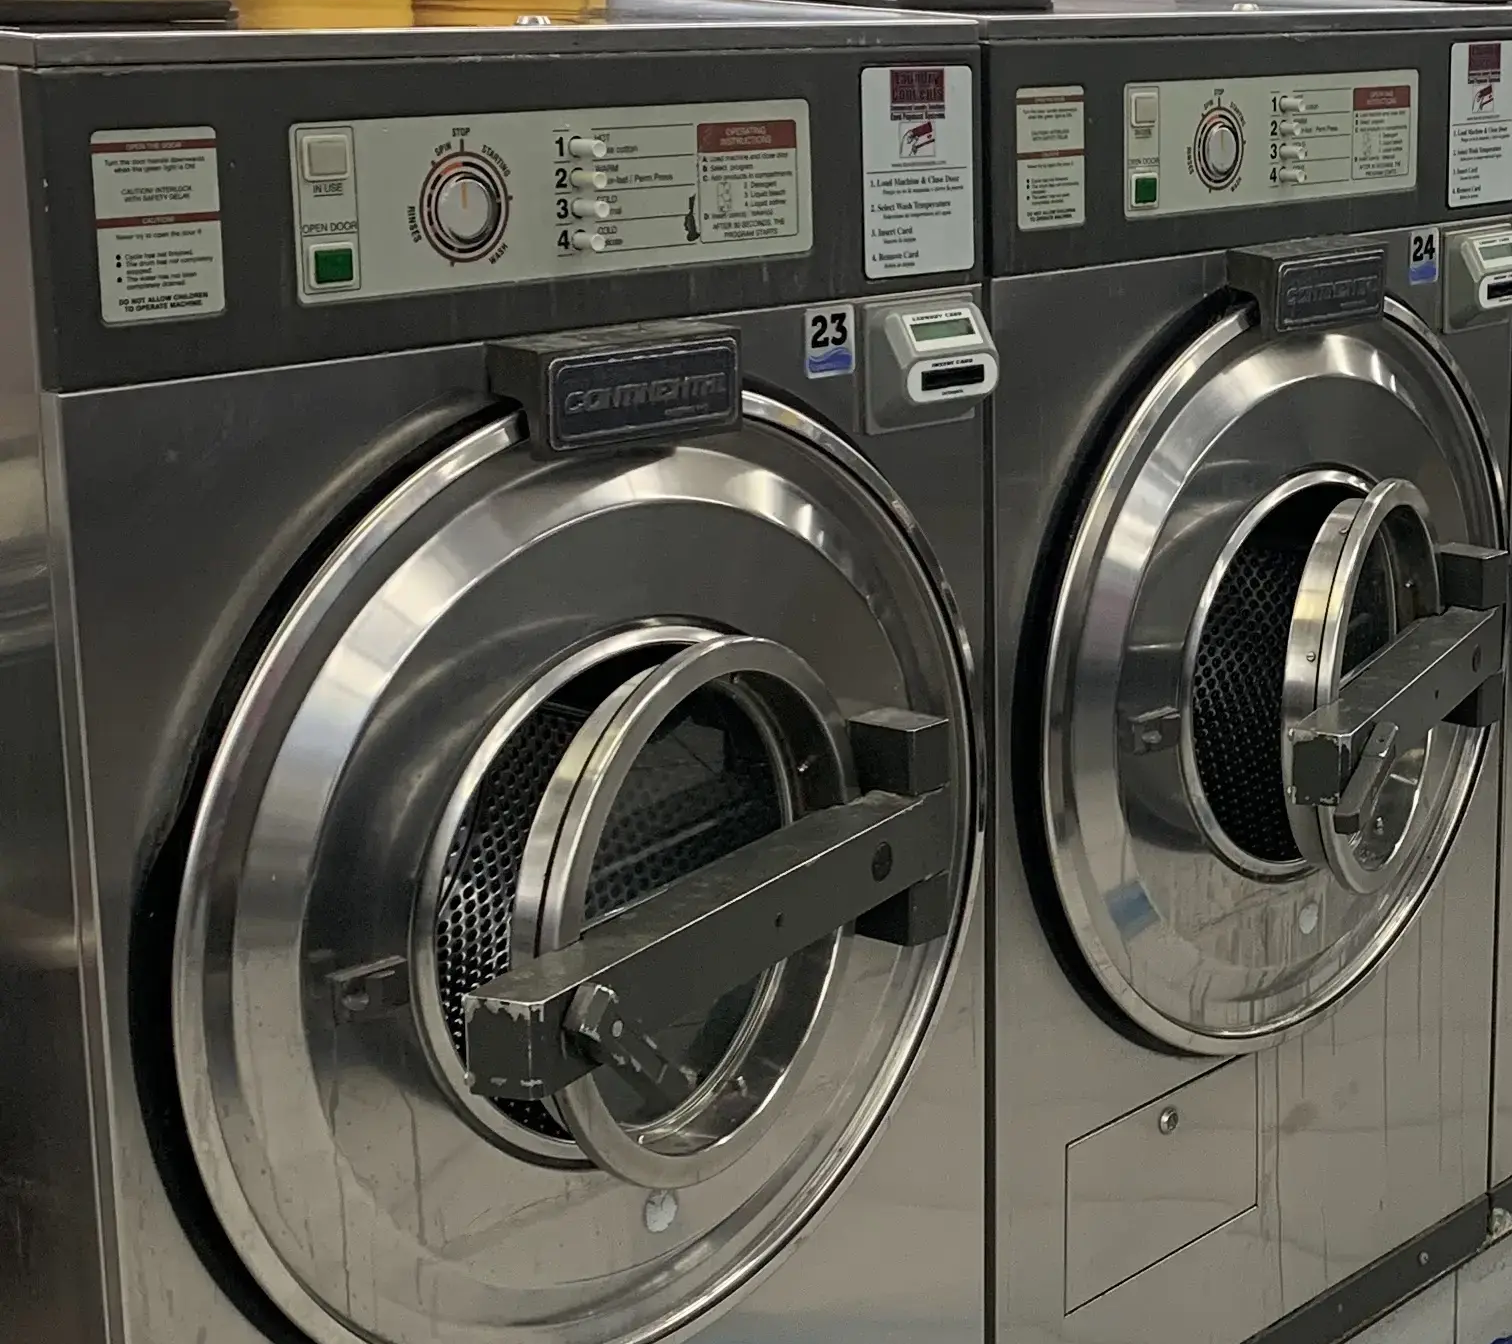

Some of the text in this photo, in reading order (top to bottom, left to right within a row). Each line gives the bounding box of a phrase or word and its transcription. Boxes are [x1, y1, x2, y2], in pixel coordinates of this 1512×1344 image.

[1271, 96, 1277, 112] 1
[452, 127, 470, 137] STOP
[1270, 119, 1278, 136] 2
[434, 141, 452, 157] SPIN
[555, 136, 564, 157] 1
[1270, 143, 1278, 160] 3
[481, 144, 512, 178] STARTING
[555, 168, 568, 188] 2
[1269, 167, 1277, 183] 4
[313, 183, 343, 193] IN USE
[556, 198, 569, 219] 3
[302, 220, 358, 234] OPEN DOOR
[407, 205, 422, 243] RINSES
[557, 230, 570, 249] 4
[1413, 234, 1435, 262] 24
[811, 312, 848, 349] 23
